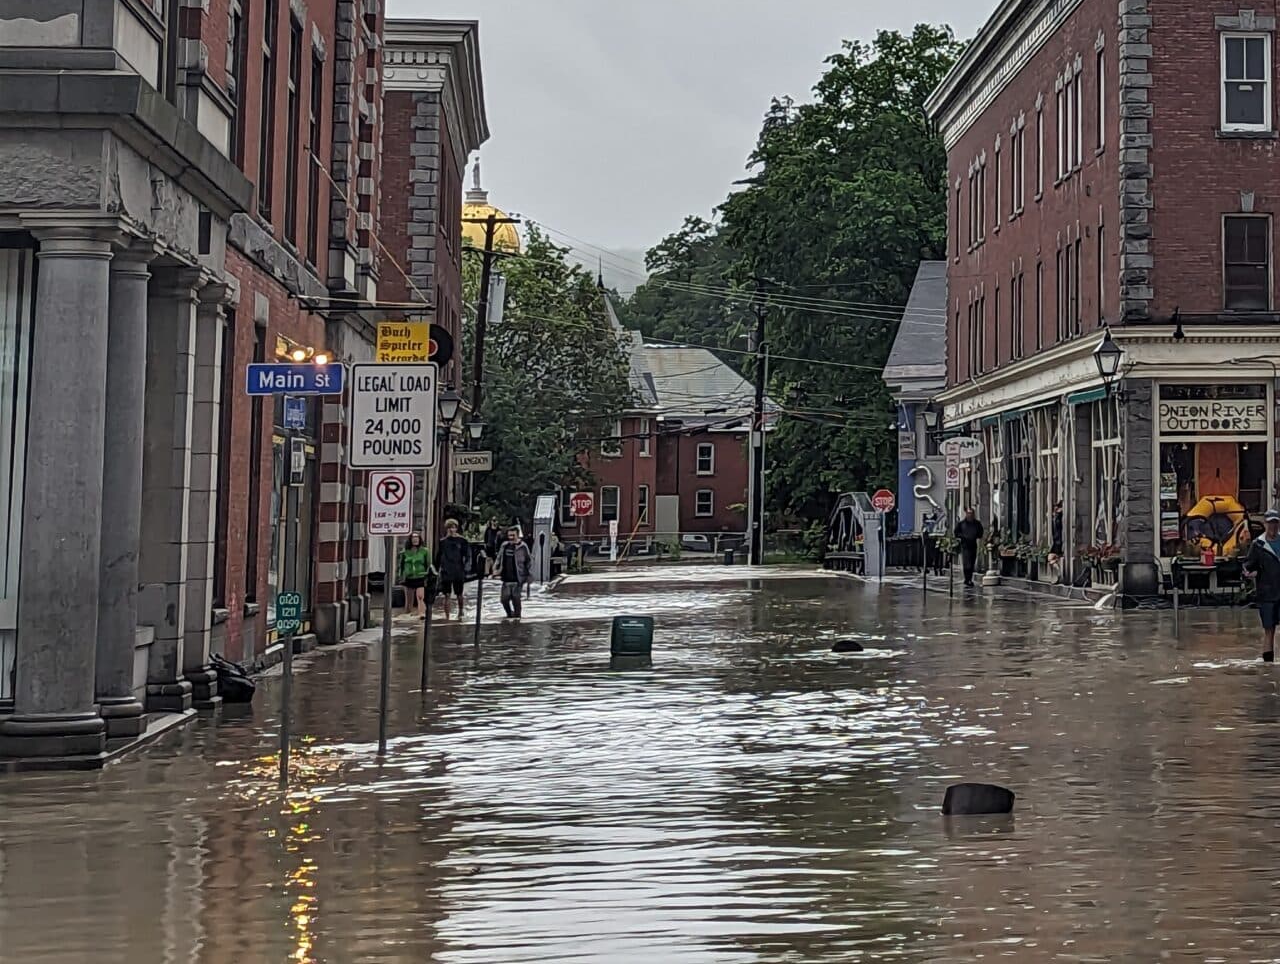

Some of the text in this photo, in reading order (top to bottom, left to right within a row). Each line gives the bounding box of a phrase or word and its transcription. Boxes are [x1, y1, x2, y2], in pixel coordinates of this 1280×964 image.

[259, 371, 330, 388] Main St
[358, 375, 430, 392] LEGAL LOAD
[376, 397, 411, 413] LIMIT
[1160, 402, 1265, 417] ONION RIVER
[365, 419, 421, 436] 24,000
[1167, 417, 1251, 430] OUTDOORS
[363, 440, 422, 455] POUNDS
[572, 500, 592, 508] STOP
[874, 496, 892, 506] STOP
